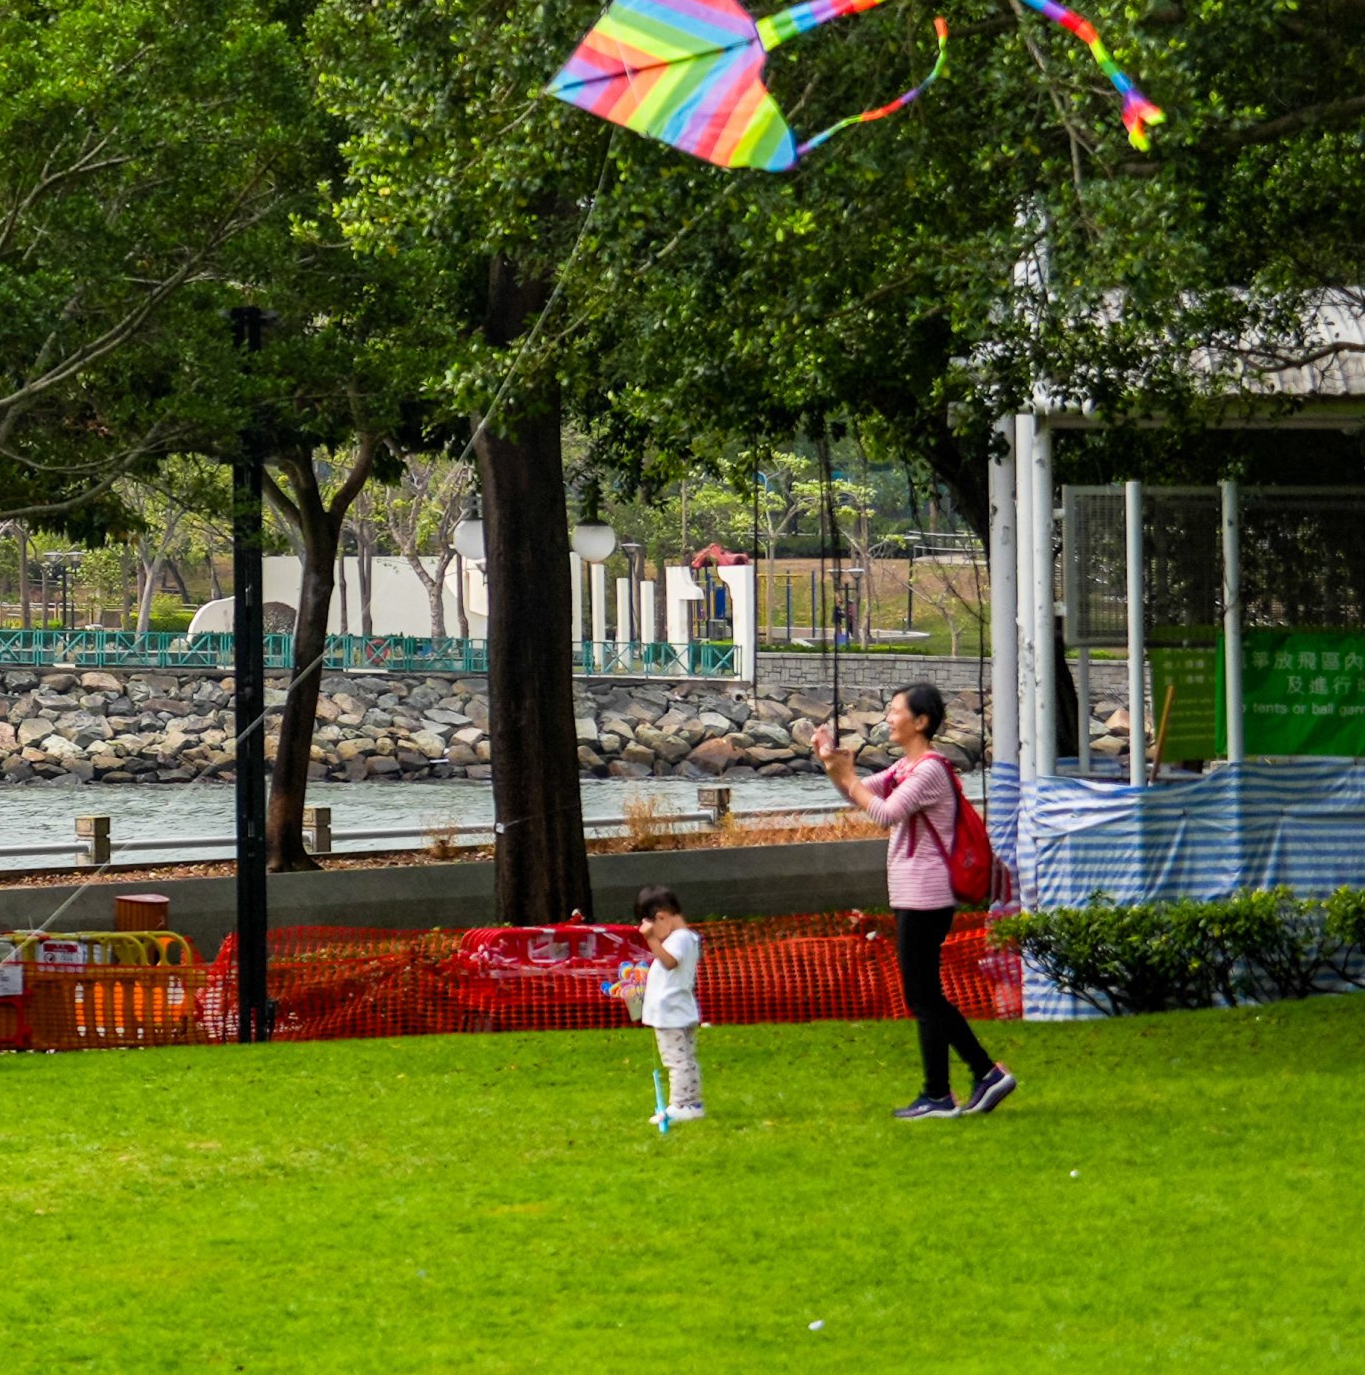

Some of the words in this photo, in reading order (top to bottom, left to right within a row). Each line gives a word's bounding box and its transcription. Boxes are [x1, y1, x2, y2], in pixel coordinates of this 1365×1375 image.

[1253, 703, 1287, 714] tents
[1292, 705, 1305, 714] or
[1311, 703, 1334, 715] ball
